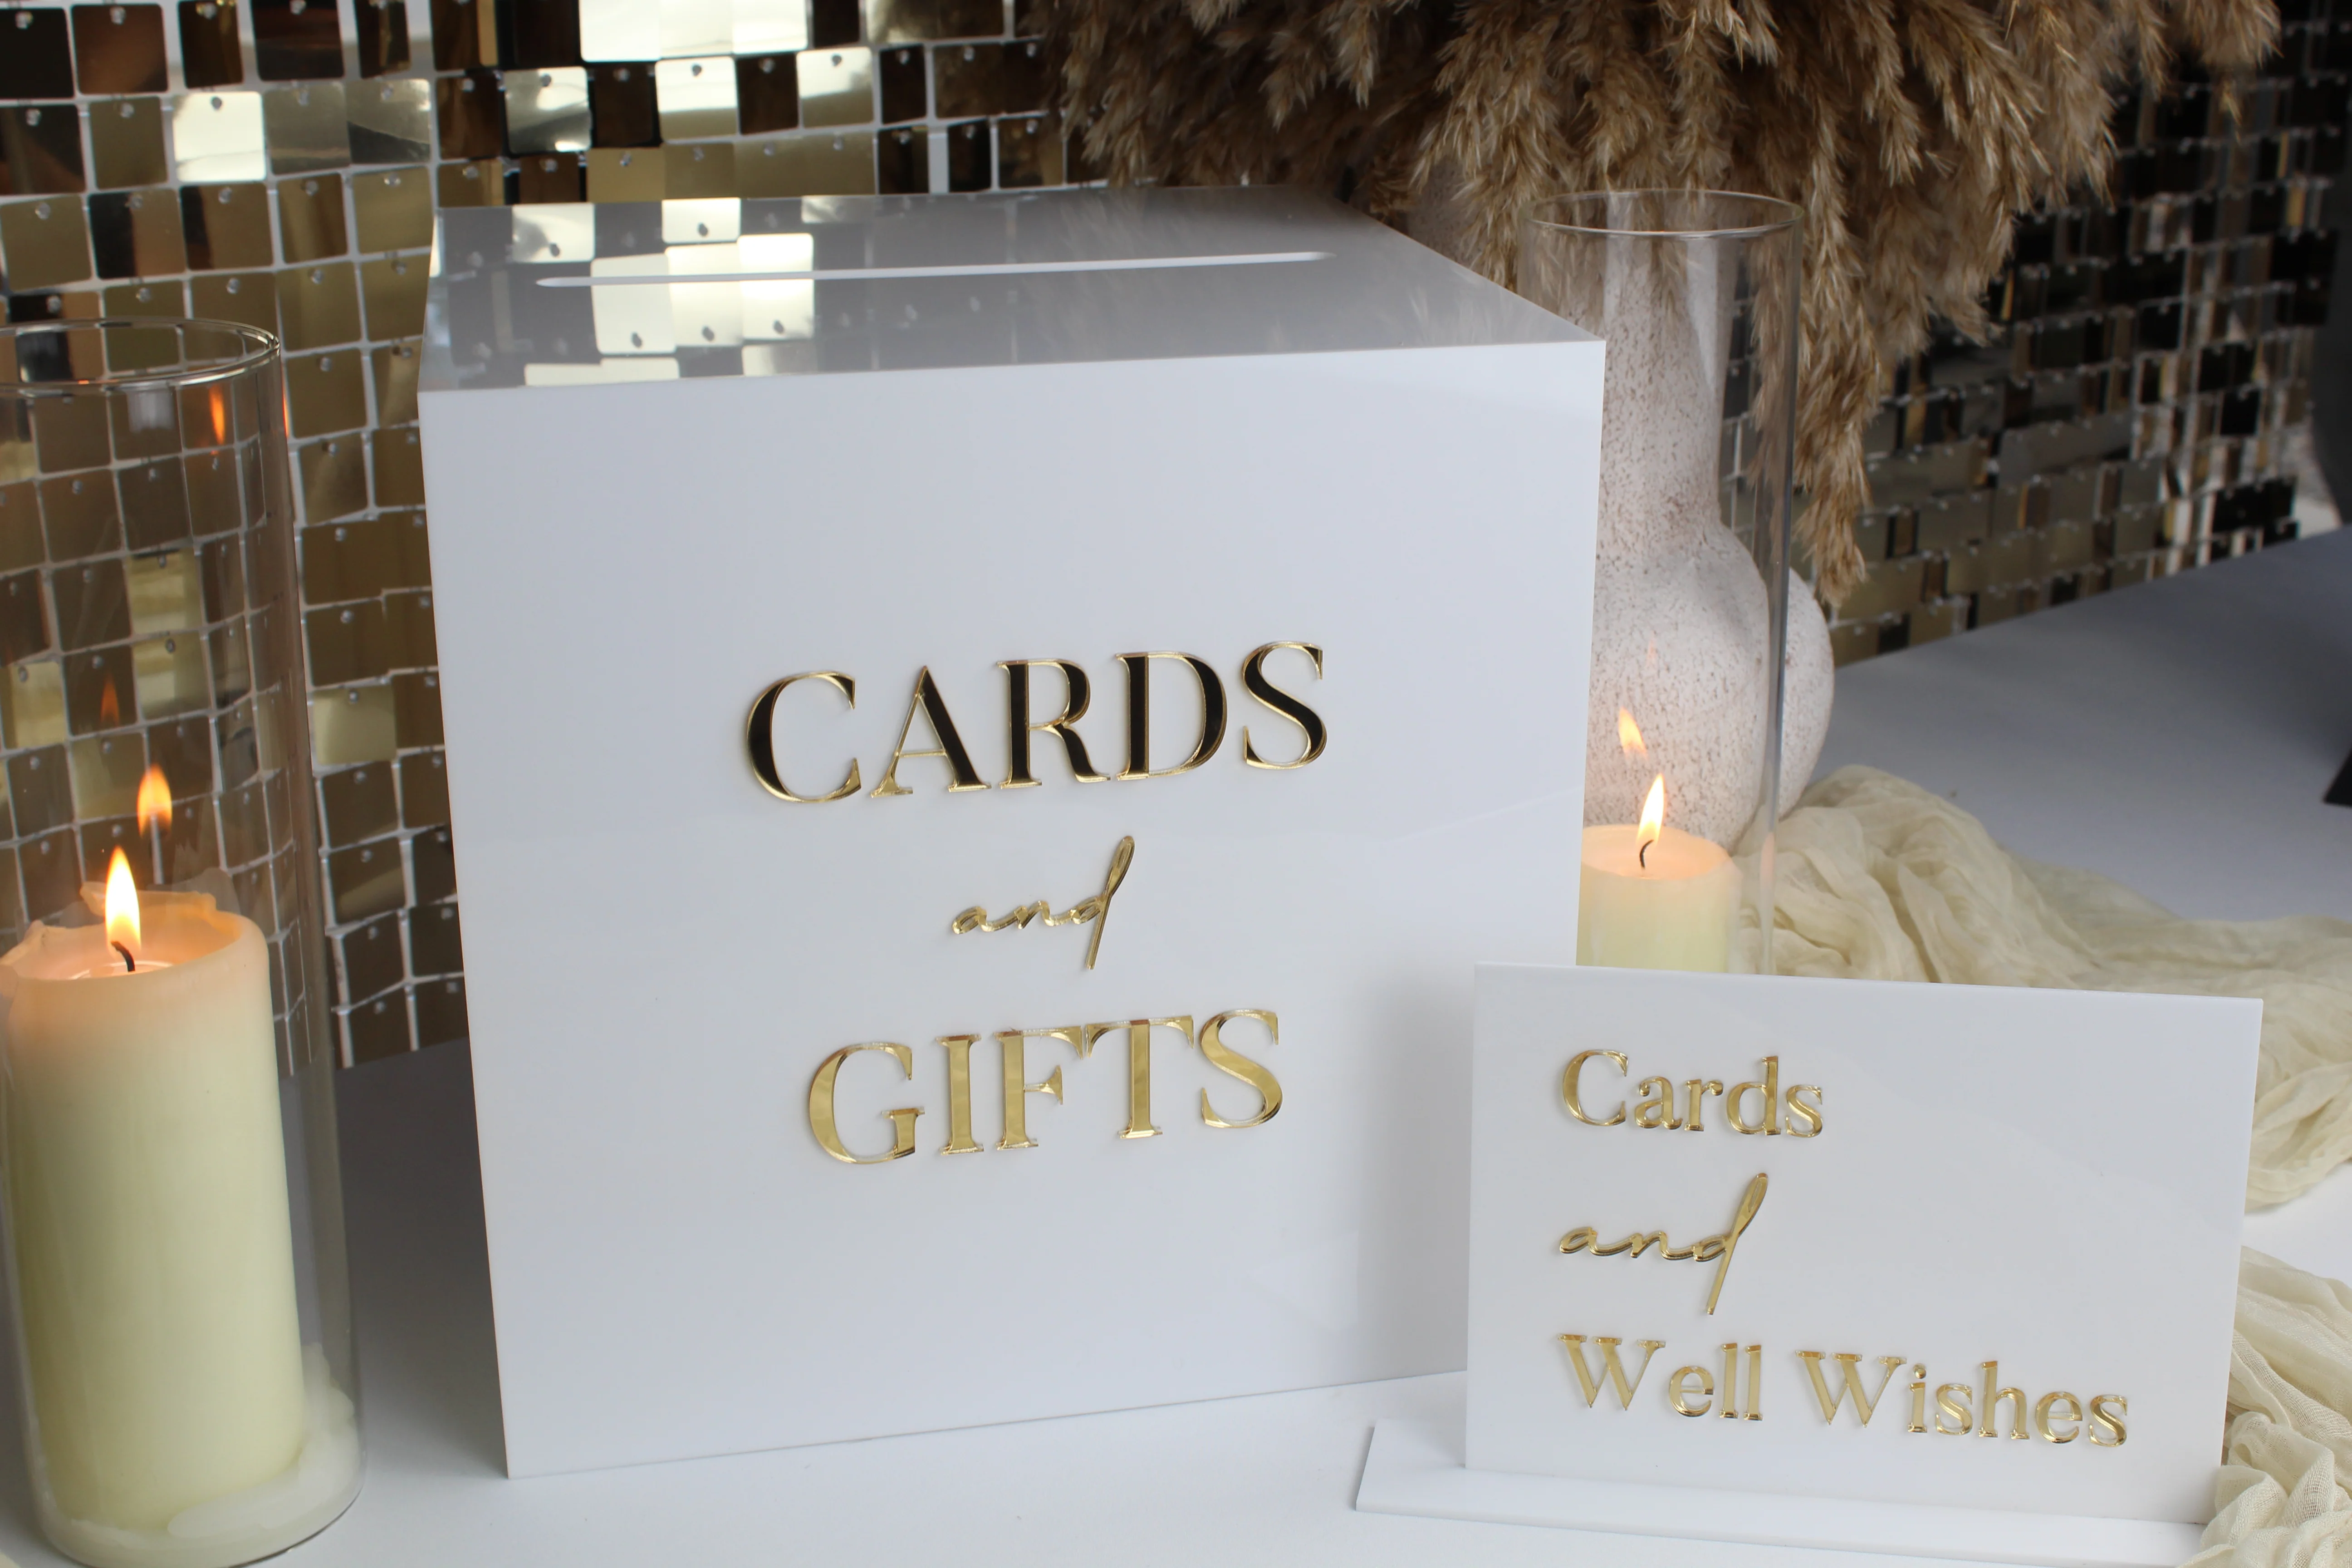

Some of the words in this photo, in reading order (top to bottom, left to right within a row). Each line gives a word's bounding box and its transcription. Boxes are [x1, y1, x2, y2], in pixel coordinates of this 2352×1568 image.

[746, 641, 1328, 804] CARDS
[951, 835, 1134, 969] and
[808, 1009, 1283, 1165] GIFTS
[1562, 1049, 1823, 1138] Cards
[1559, 1172, 1768, 1315] and
[1557, 1333, 1763, 1421] Well
[1796, 1350, 2128, 1447] Wishes
